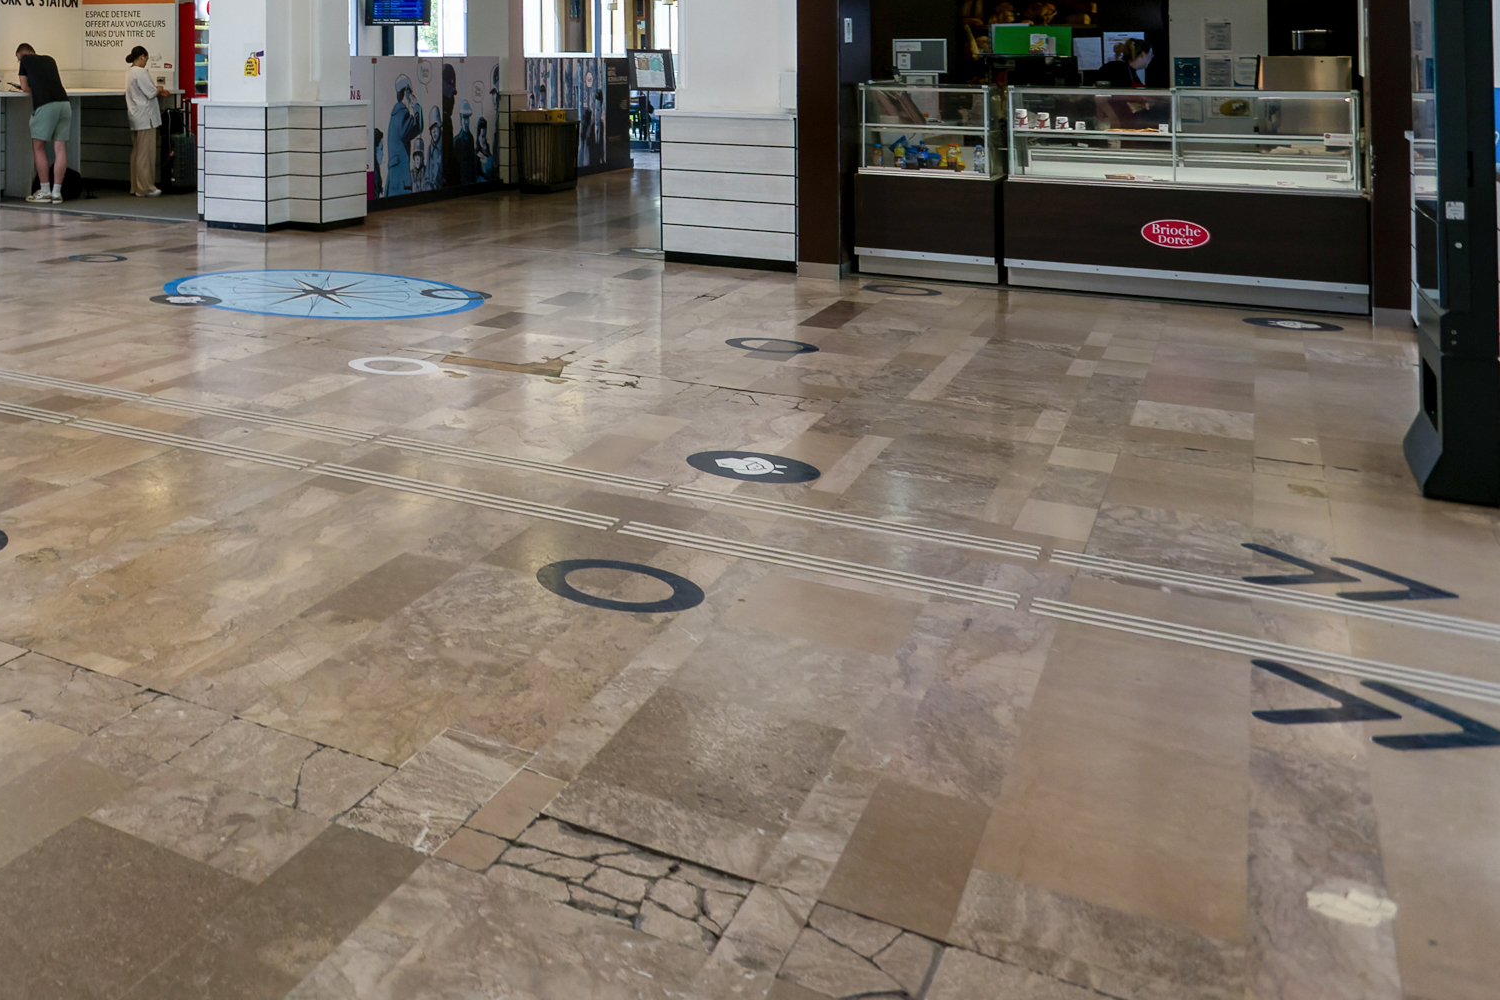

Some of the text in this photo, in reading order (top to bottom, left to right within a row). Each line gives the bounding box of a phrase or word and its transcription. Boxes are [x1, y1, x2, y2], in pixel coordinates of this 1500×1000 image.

[86, 20, 110, 28] OFFERT
[1152, 223, 1201, 237] Brioche
[1158, 234, 1194, 245] Dorée
